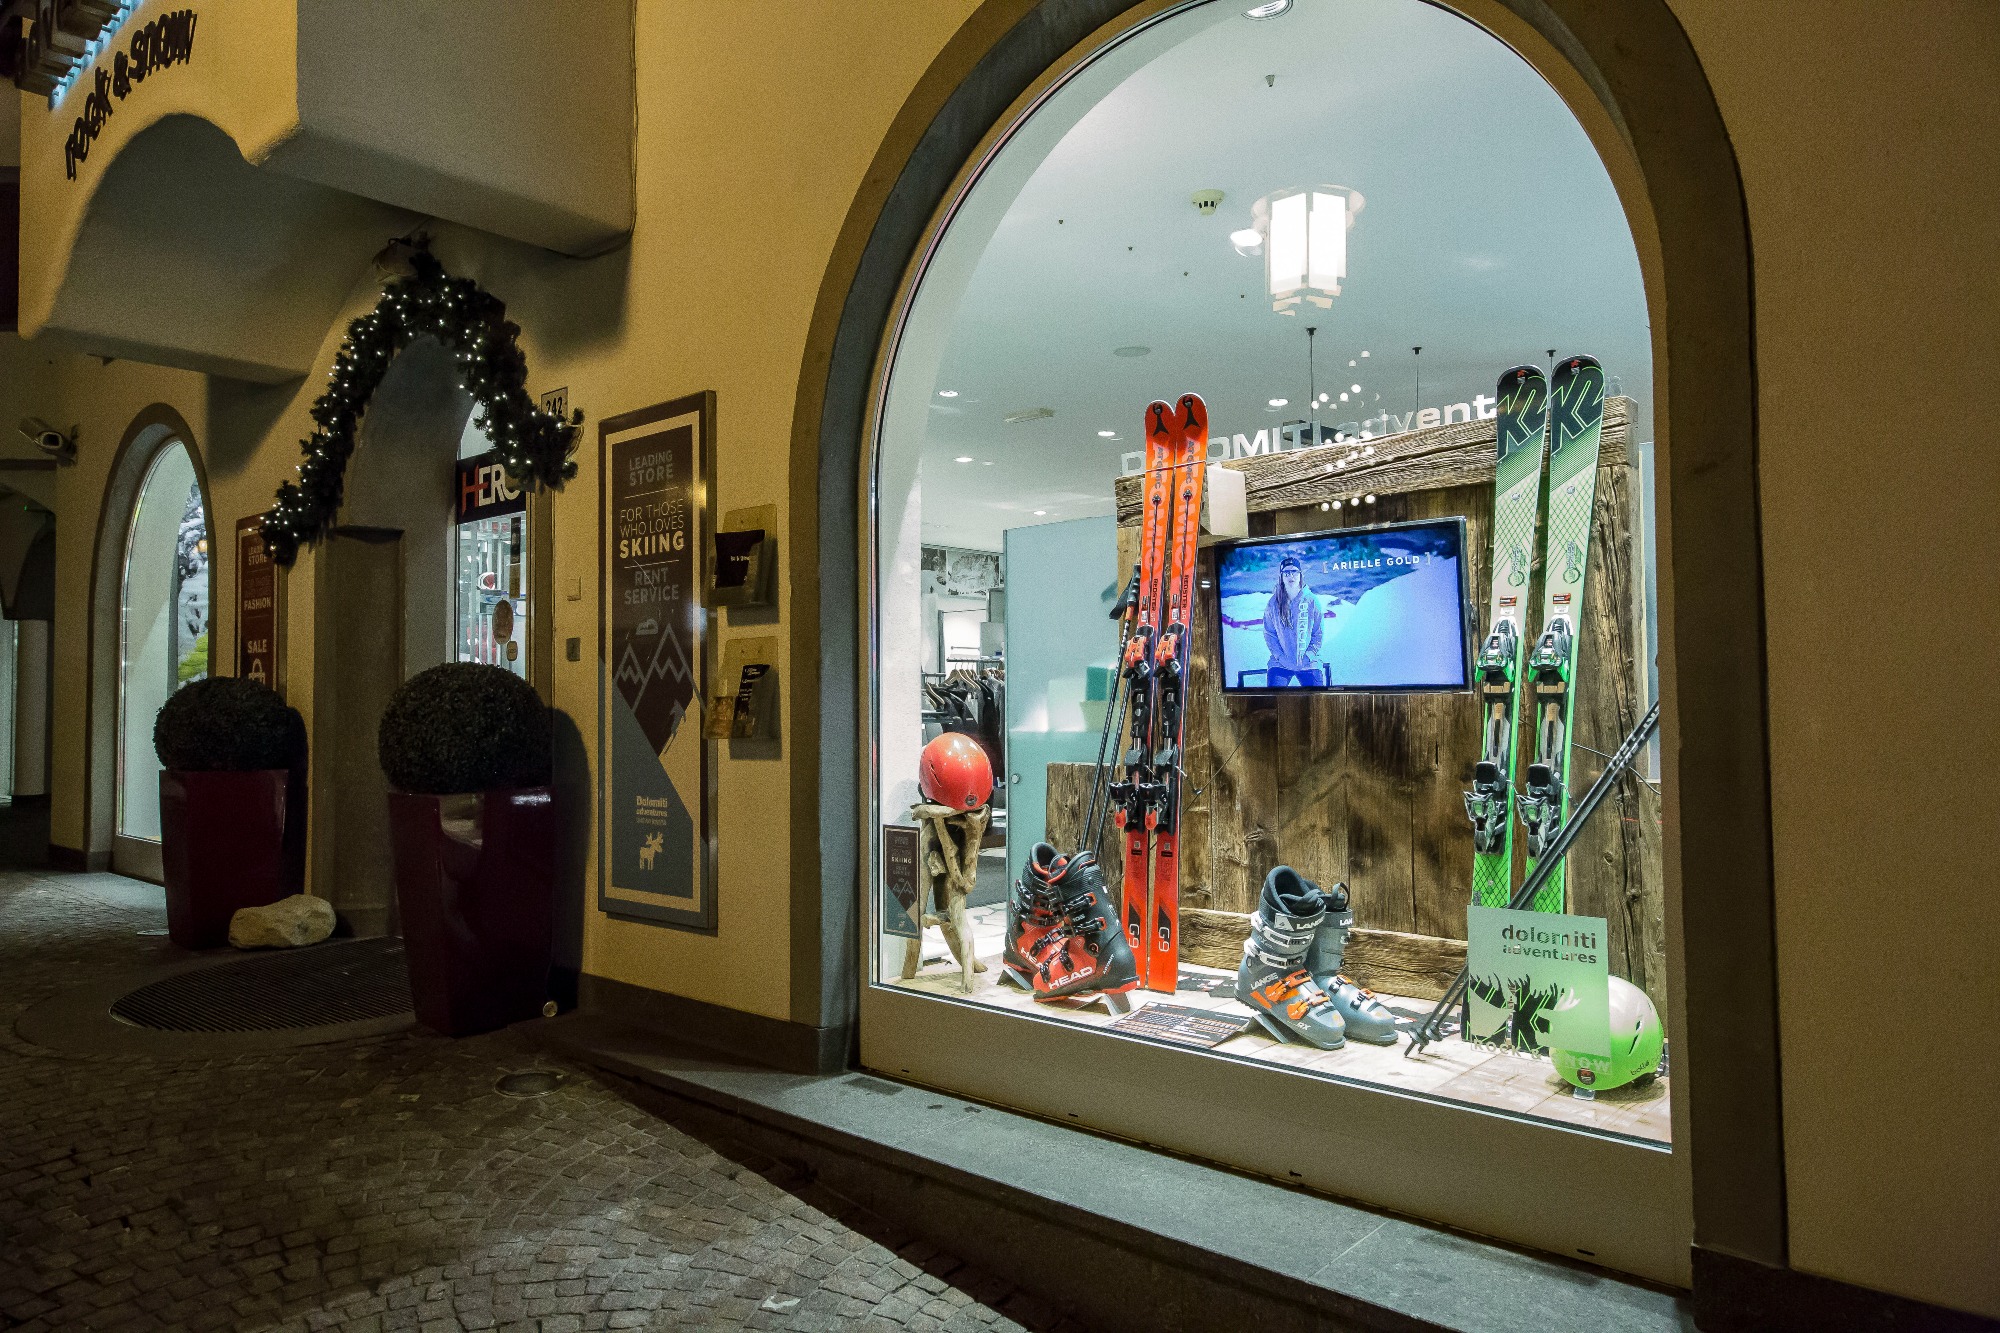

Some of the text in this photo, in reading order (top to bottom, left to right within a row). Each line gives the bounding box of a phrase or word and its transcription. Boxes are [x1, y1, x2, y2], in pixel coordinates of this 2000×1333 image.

[546, 396, 562, 416] 242
[1120, 420, 1321, 477] DOMITI
[629, 450, 674, 471] LEADING
[629, 463, 674, 487] STORE
[620, 498, 684, 523] FOR THOSE
[620, 514, 684, 538] WHO LOVES
[619, 530, 685, 559] SKIING
[248, 553, 267, 566] STORE
[1333, 555, 1420, 571] ARIELLE GOLD
[634, 566, 669, 586] RENT
[243, 597, 272, 611] FASHION
[624, 584, 679, 606] SERVICE
[247, 639, 267, 653] SALE
[636, 795, 668, 808] Dolomiti
[1296, 914, 1325, 930] LANGE
[1339, 916, 1354, 927] LAN
[1127, 923, 1141, 949] G9
[1158, 926, 1171, 953] G9
[1501, 924, 1597, 950] dolomiti
[1502, 944, 1598, 964] adventures
[1048, 965, 1094, 990] HEAD
[1250, 972, 1279, 990] LANGE
[1297, 1021, 1312, 1031] RX
